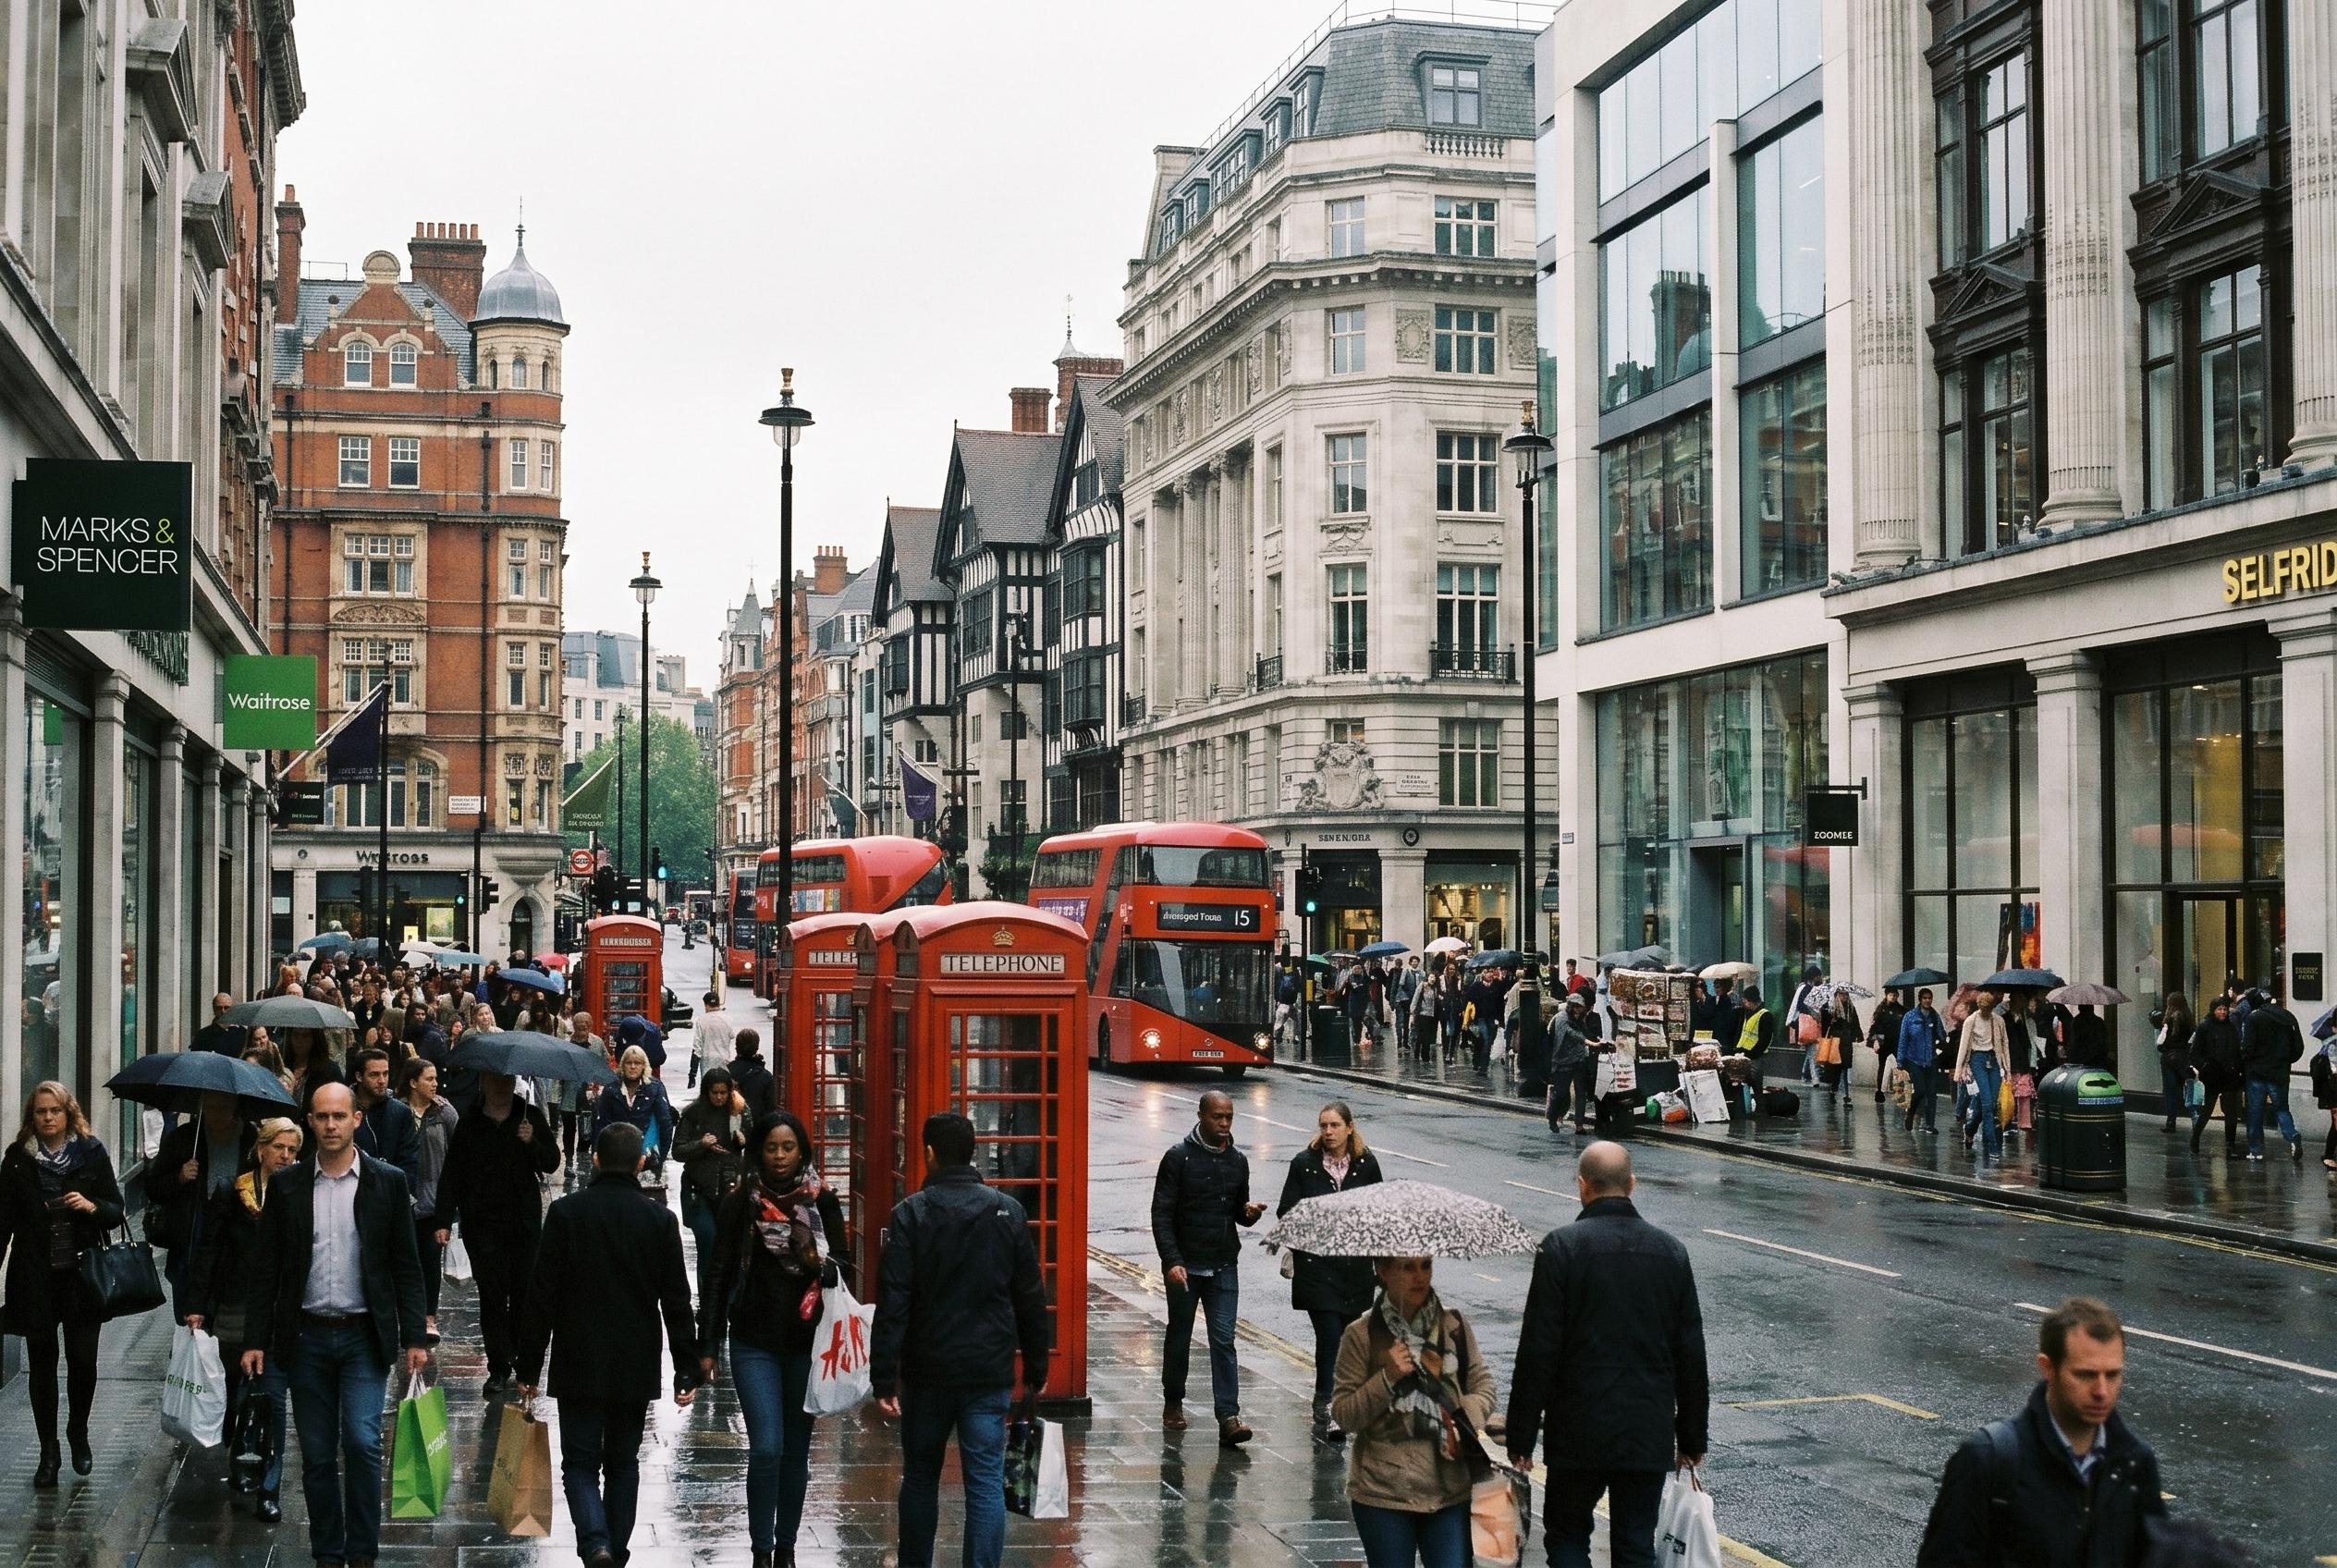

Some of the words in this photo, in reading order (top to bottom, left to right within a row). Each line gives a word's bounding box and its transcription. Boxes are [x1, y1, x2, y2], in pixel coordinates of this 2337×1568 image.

[41, 516, 150, 543] MARKS
[154, 518, 176, 544] &
[36, 546, 178, 575] SPENCER
[2222, 541, 2337, 603] SELFRID
[227, 692, 311, 710] Waitrose
[1234, 910, 1250, 926] 15
[945, 955, 1061, 972] TELEPHONE
